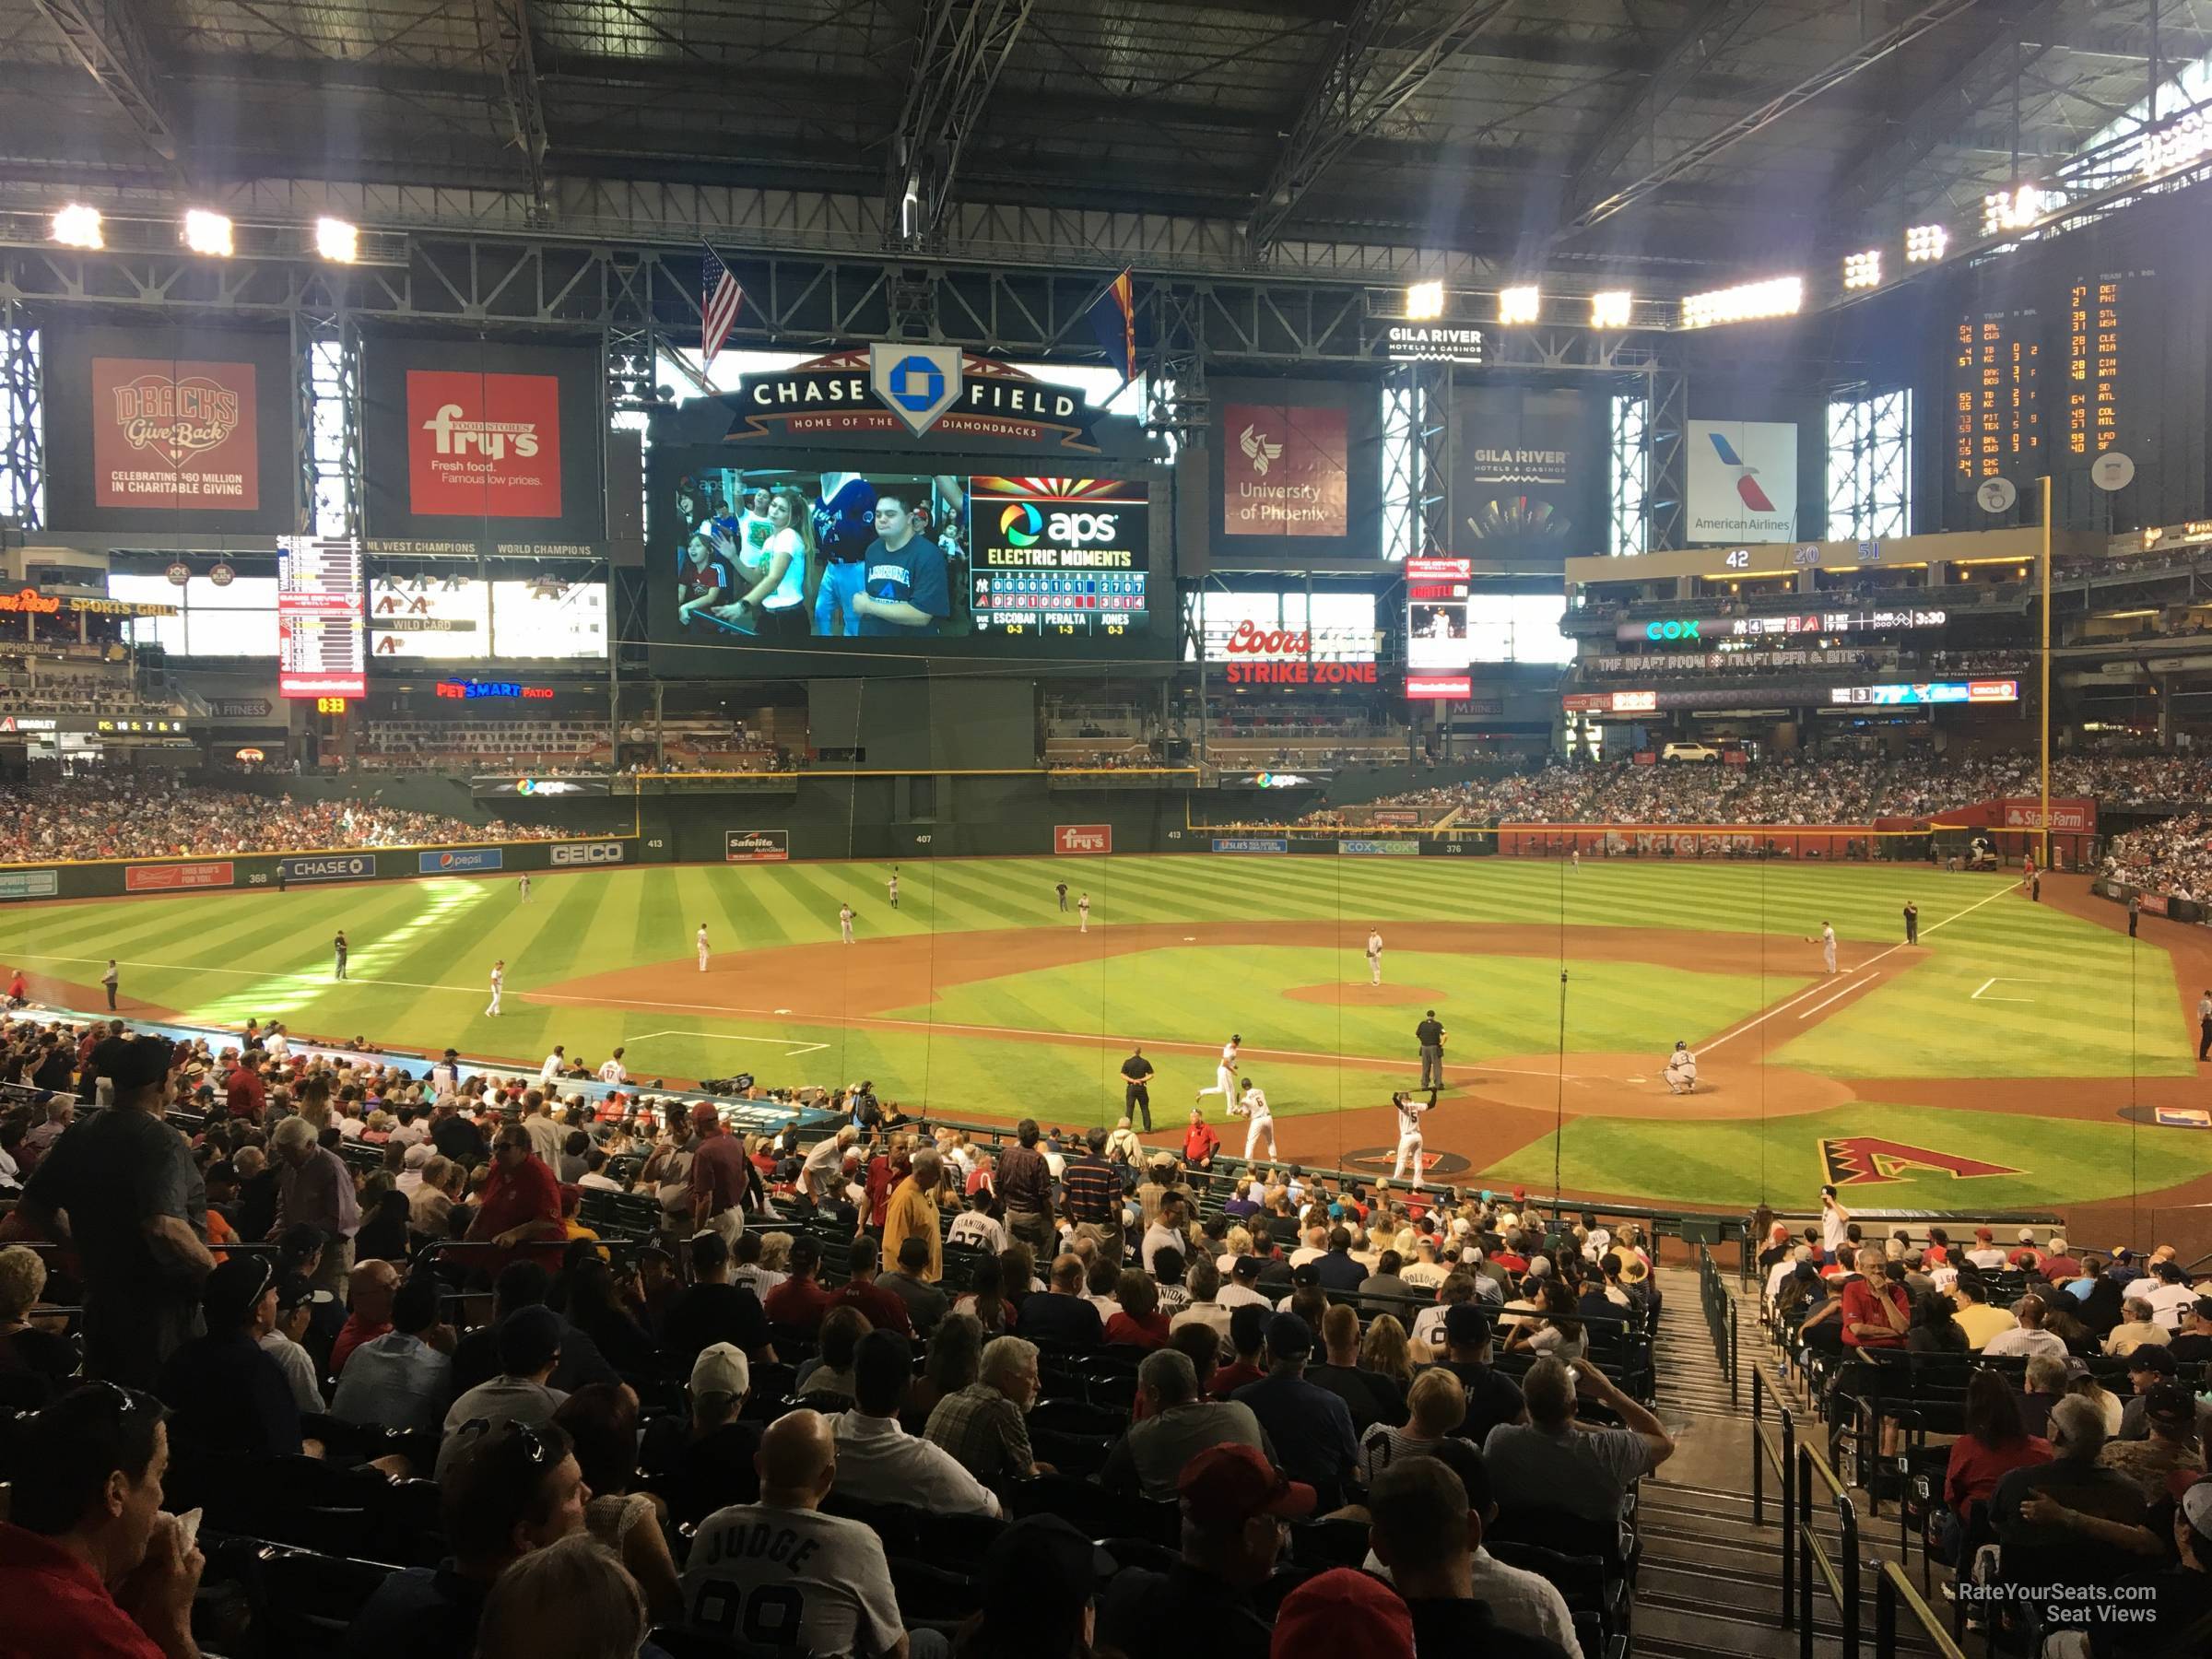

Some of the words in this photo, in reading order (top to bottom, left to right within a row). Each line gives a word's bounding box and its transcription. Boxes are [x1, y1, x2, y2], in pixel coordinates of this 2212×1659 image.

[2072, 287, 2086, 296] 47
[2100, 284, 2116, 293] DET
[2100, 295, 2115, 303] PHI
[2072, 311, 2086, 321] 39
[2100, 310, 2116, 318] STL
[2073, 322, 2086, 331] 31
[2100, 319, 2116, 327] WSH
[1389, 327, 1429, 342] GILA
[1431, 329, 1482, 344] RIVER
[2072, 336, 2086, 346] 28
[2100, 334, 2116, 343] CLE
[2072, 346, 2086, 356] 31
[2100, 344, 2116, 352] MIA
[2072, 359, 2086, 370] 28
[2099, 359, 2116, 367] CIN
[752, 380, 864, 406] CHASE
[971, 384, 1075, 418] FIELD
[422, 404, 539, 461] fry's
[453, 421, 483, 430] FOOD
[487, 422, 532, 432] STORES
[794, 418, 832, 429] HOME
[842, 418, 858, 427] OF
[868, 417, 894, 427] THE
[942, 419, 1038, 438] DIAMONDBACKS
[128, 419, 171, 444] Give
[172, 422, 224, 448] Back
[1475, 449, 1512, 463] GILA
[1516, 451, 1566, 464] RIVER
[431, 461, 464, 471] Fresh
[467, 462, 497, 472] food.
[112, 471, 177, 482] CELEBRATING
[181, 472, 200, 482] $60
[202, 474, 242, 484] MILLION
[441, 473, 485, 485] Famous
[488, 474, 506, 486] low
[508, 476, 543, 487] prices.
[112, 482, 124, 492] IN
[128, 482, 199, 494] CHARITABLE
[203, 483, 242, 495] GIVING
[1240, 482, 1321, 503] University
[1241, 503, 1259, 520] of
[1261, 505, 1325, 522] Phoenix
[1048, 512, 1116, 547] aps
[1695, 518, 1747, 530] American
[1749, 519, 1790, 530] Airlines
[367, 541, 380, 552] NL
[382, 542, 413, 552] WEST
[414, 542, 476, 553] CHAMPIONS
[498, 544, 531, 554] WORLD
[534, 546, 591, 556] CHAMPIONS
[1858, 541, 1880, 560] 51
[988, 548, 1057, 566] ELECTRIC
[1061, 549, 1132, 567] MOMENTS
[1726, 550, 1749, 568] 42
[1793, 546, 1819, 564] 20
[994, 581, 1001, 591] 0
[1006, 581, 1012, 591] 0
[71, 597, 132, 616] SPORTS
[136, 604, 179, 617] GRILL
[994, 613, 1036, 624] ESCOBAR
[1045, 614, 1086, 625] PERALTA
[1100, 614, 1129, 625] JONES
[1915, 611, 1946, 625] 3:30
[394, 620, 420, 630] WILD
[423, 620, 451, 630] CARD
[1006, 626, 1023, 634] 0-3
[1059, 626, 1074, 634] 1-3
[1108, 627, 1124, 635] 0-3
[1647, 619, 1700, 641] COX
[1751, 621, 1759, 630] 4
[1227, 619, 1311, 653] Coors
[1599, 658, 1621, 671] THE
[1625, 656, 1665, 671] DRAFT
[1668, 654, 1706, 669] ROOM
[1727, 653, 1769, 666] CRAFT
[1772, 651, 1806, 665] BEER
[1810, 651, 1823, 663] &
[1227, 663, 1309, 683] STRIKE
[1313, 664, 1377, 684] ZONE
[1857, 689, 1866, 700] 3
[223, 705, 266, 716] FITNESS
[146, 722, 153, 731] 7
[172, 723, 181, 732] 9
[2053, 811, 2082, 828] Farm
[647, 840, 664, 848] 413
[730, 838, 773, 848] Safelite
[916, 834, 933, 843] 407
[1062, 828, 1104, 850] fry's
[1221, 840, 1248, 851] LESLIE'S
[1347, 842, 1372, 853] COX
[1385, 842, 1410, 853] COX
[1446, 844, 1462, 853] 376
[454, 853, 482, 866] pepsi
[552, 844, 621, 863] GEICO
[182, 867, 197, 876] THIS
[295, 861, 347, 876] CHASE
[182, 875, 196, 884] FOR
[249, 874, 267, 884] 368
[606, 1068, 615, 1079] 17
[1410, 1112, 1418, 1124] 5
[956, 1218, 986, 1231] STANTON
[707, 1522, 821, 1574] JUDGE
